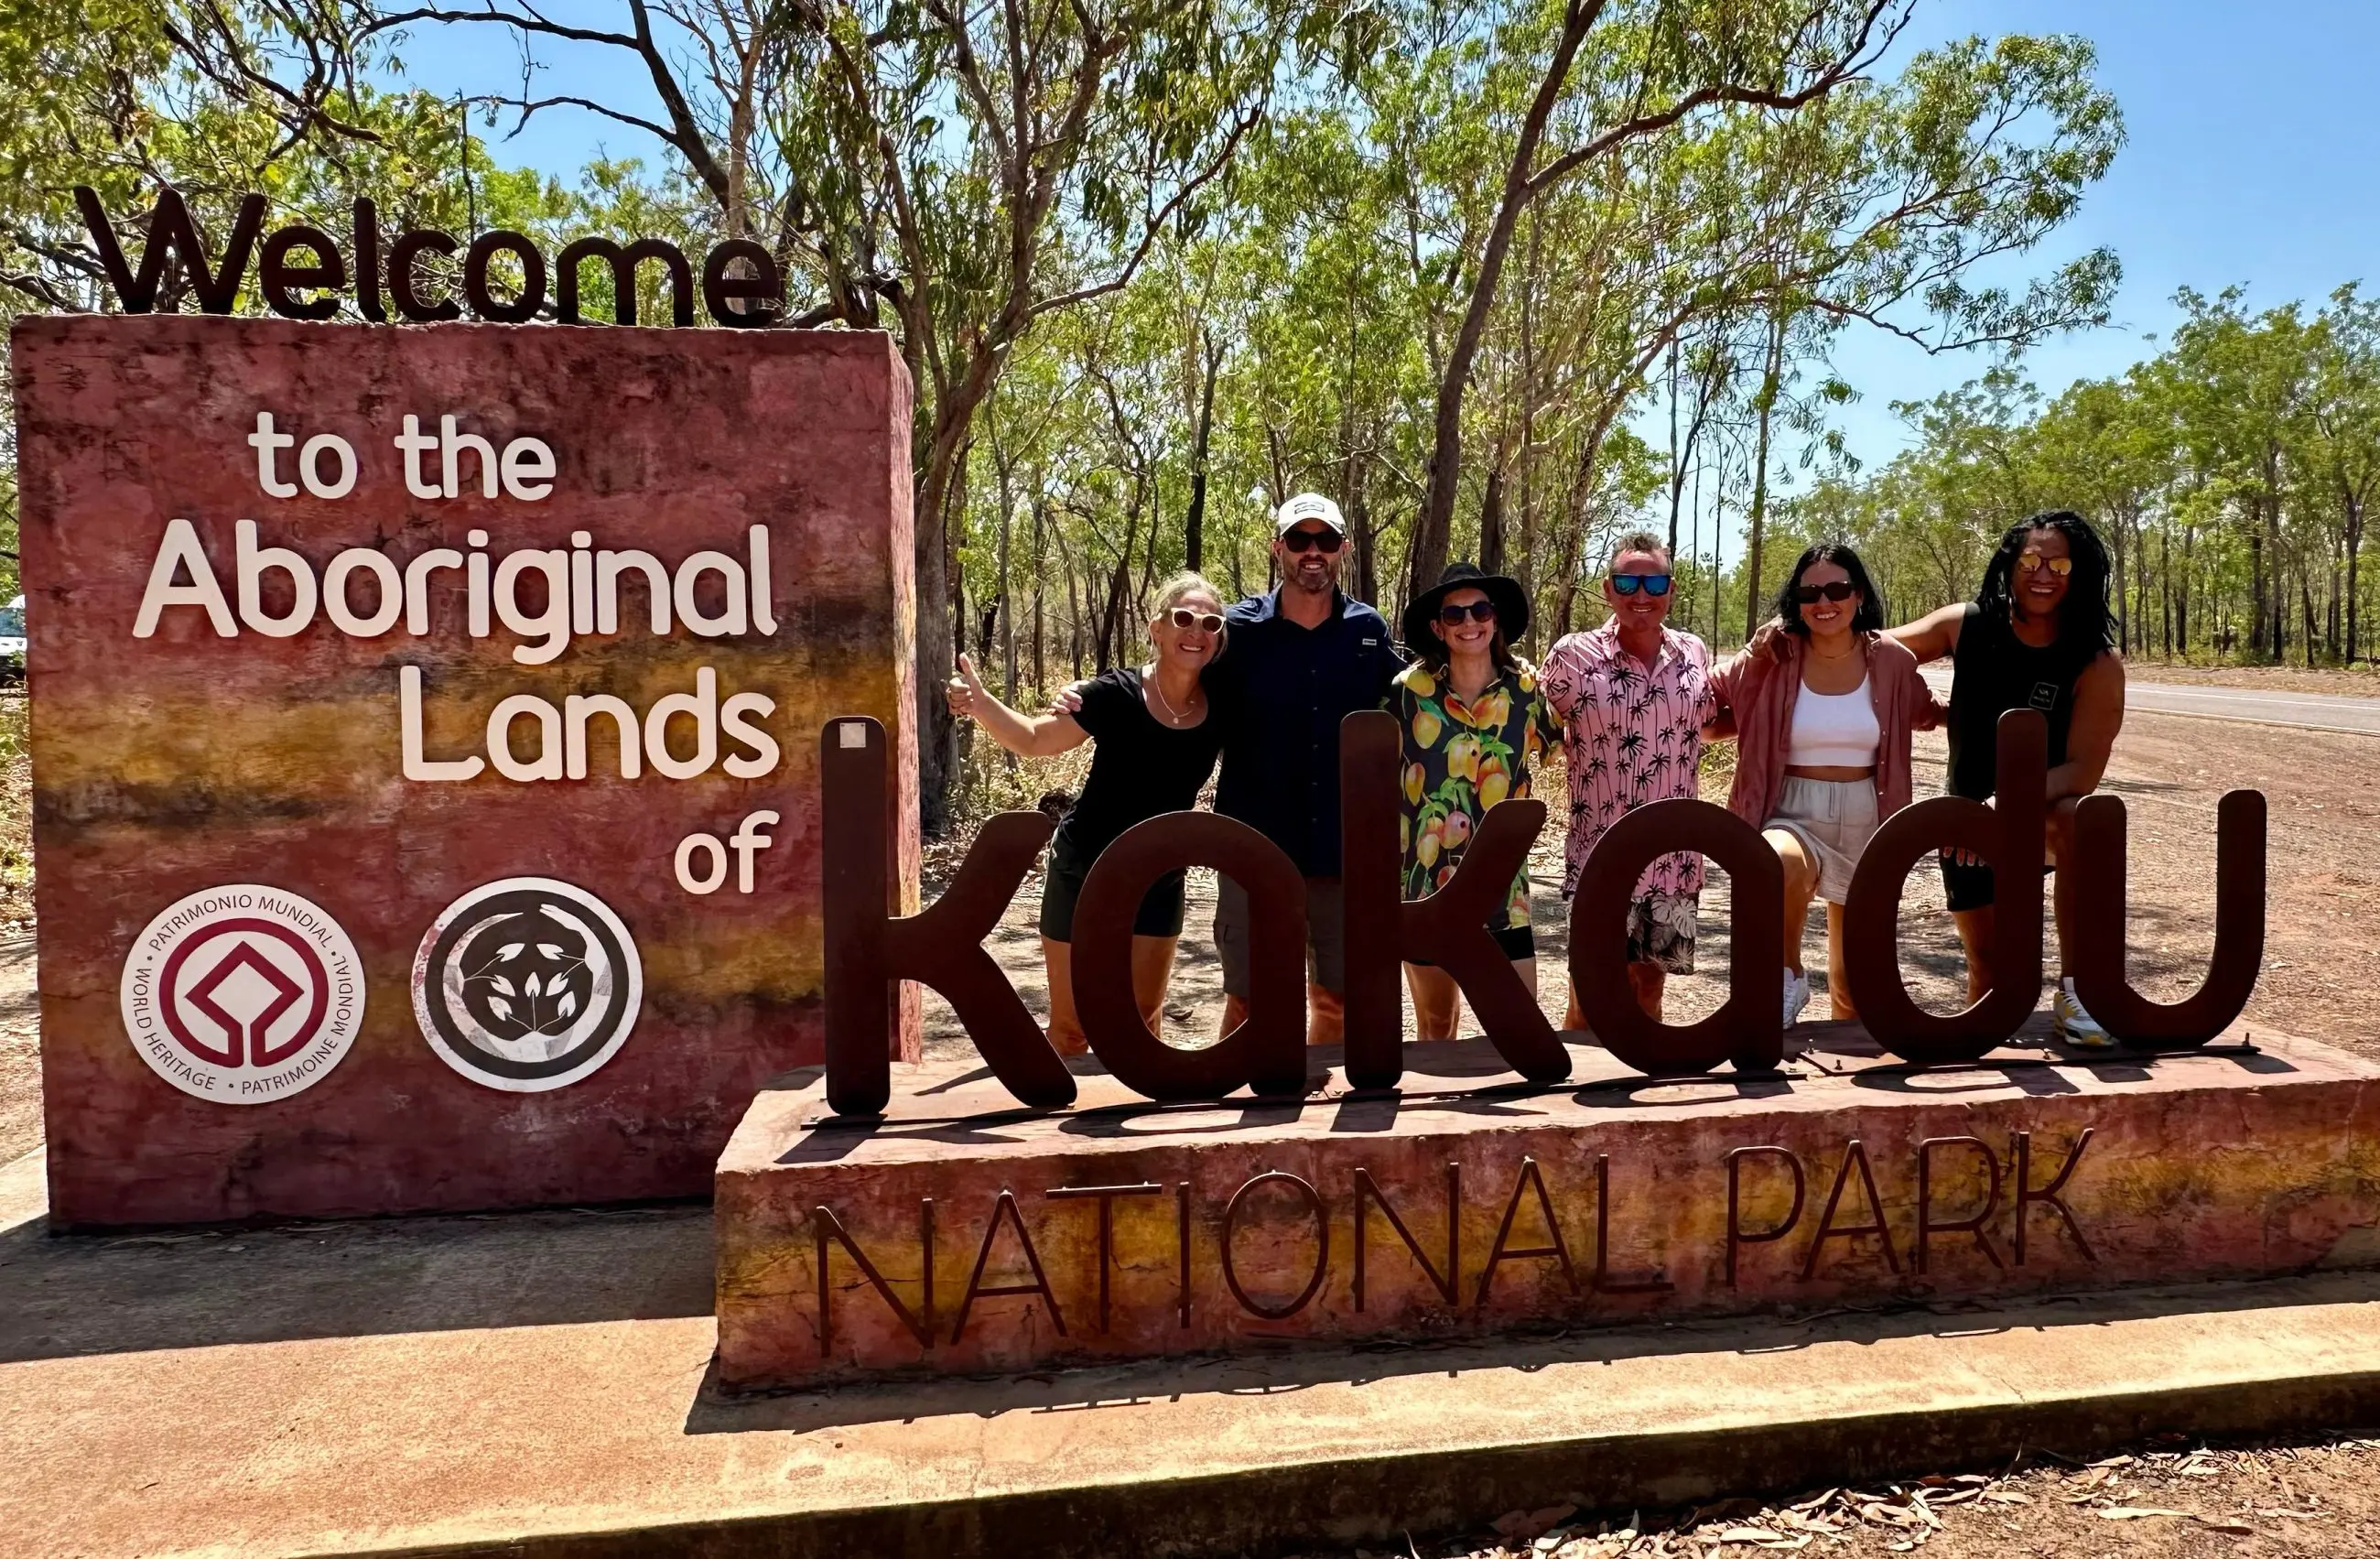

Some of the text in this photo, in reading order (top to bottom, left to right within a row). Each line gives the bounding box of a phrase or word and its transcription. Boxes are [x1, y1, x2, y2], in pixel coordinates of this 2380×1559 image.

[74, 186, 781, 328] Welcome
[247, 412, 557, 501] to the
[133, 519, 778, 666] Aboriginal
[400, 666, 780, 782] Lands
[674, 810, 780, 894] of
[820, 709, 2266, 1117] kakadu
[148, 894, 333, 951] PATRIMONIO MUNDIAL
[133, 968, 216, 1090] WORLD HERITAGE
[241, 956, 353, 1095] PATRIMOINE MONDIAL
[816, 1128, 2097, 1359] NATIONAL PARK
